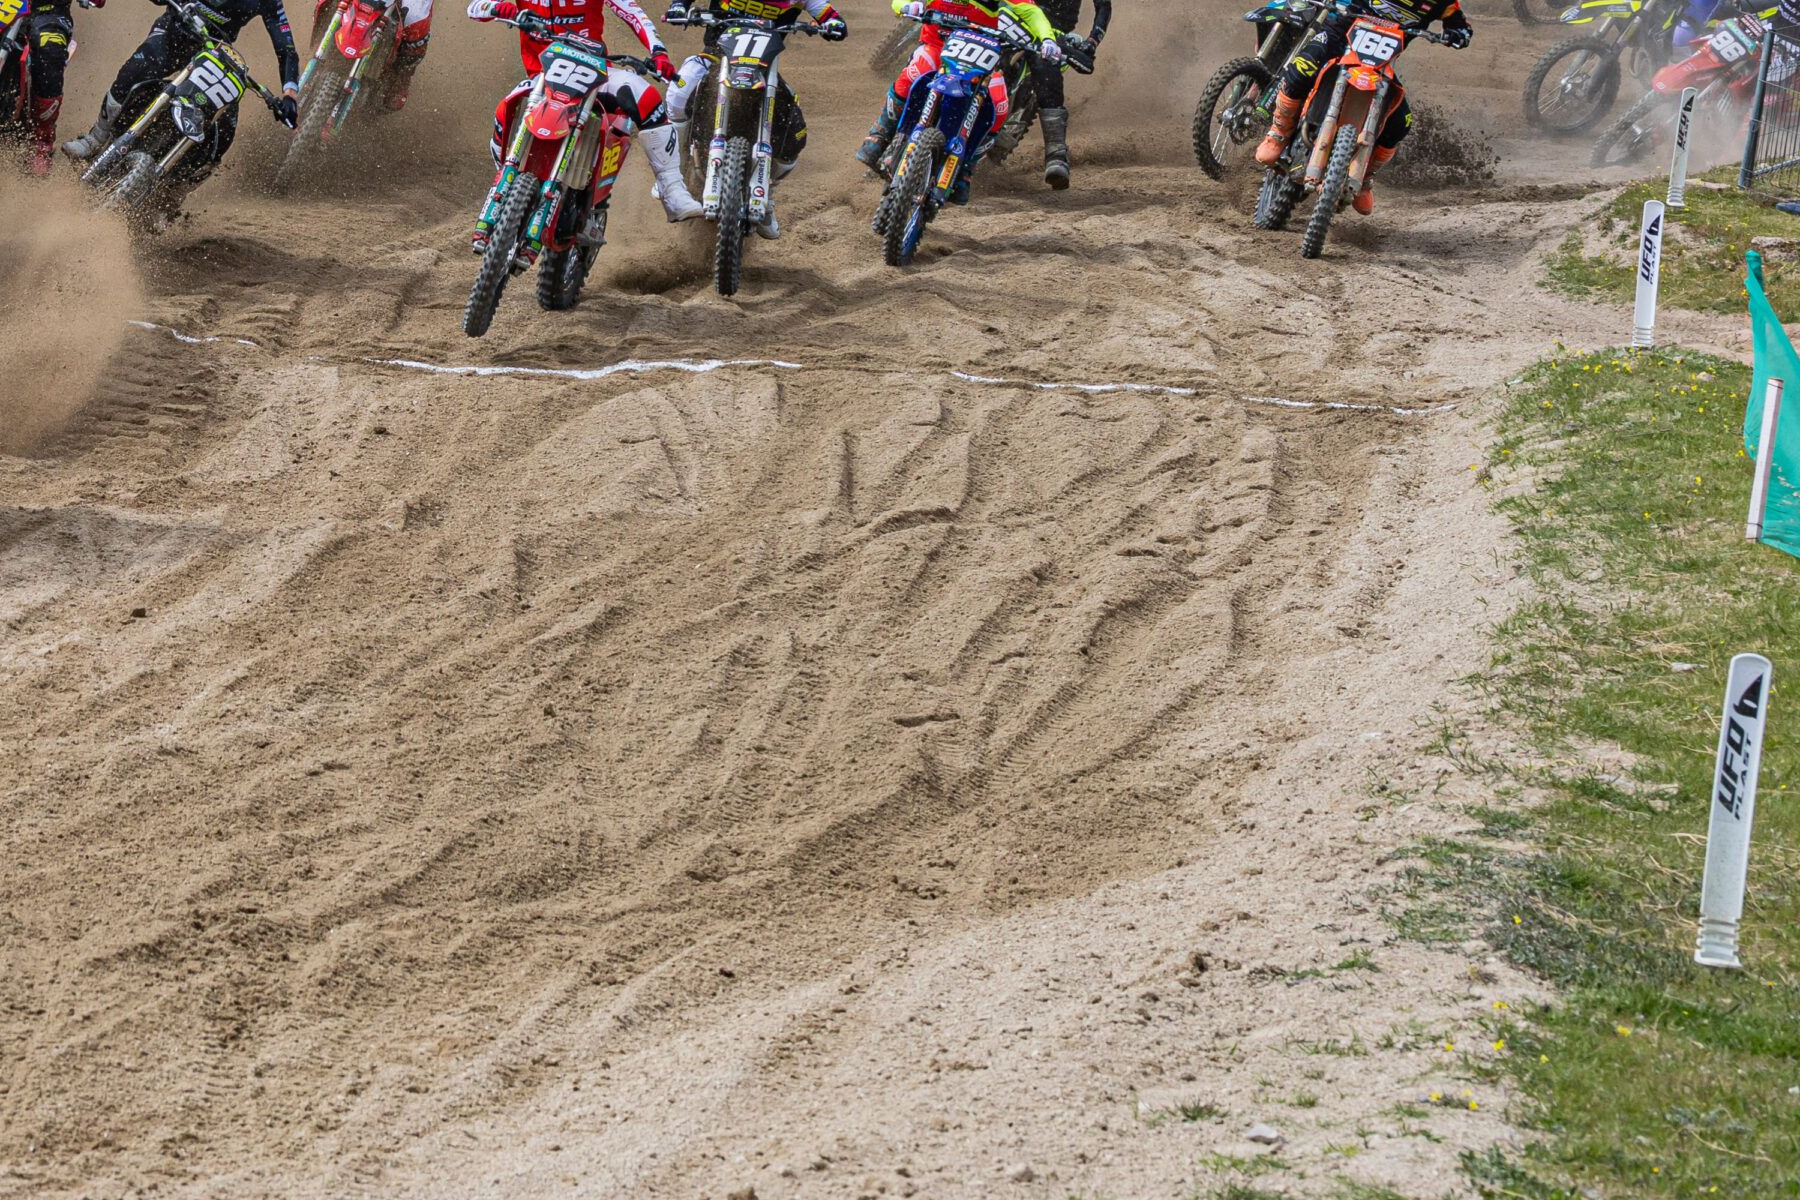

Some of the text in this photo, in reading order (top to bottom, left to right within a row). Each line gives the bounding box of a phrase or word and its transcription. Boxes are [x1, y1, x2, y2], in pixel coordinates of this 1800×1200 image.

[732, 33, 772, 59] 11
[939, 38, 1000, 72] 300
[955, 30, 999, 48] E.CASTRO
[1351, 29, 1400, 61] 166
[1709, 30, 1747, 63] 96
[561, 47, 603, 70] MOTOREX
[544, 57, 599, 95] 82
[963, 97, 981, 131] GOBY
[1676, 113, 1689, 150] UFO
[600, 144, 622, 177] 82
[1640, 234, 1654, 284] UFO
[1648, 243, 1659, 286] PLAST
[1717, 715, 1746, 814] UFO
[1733, 738, 1754, 822] PLAST
